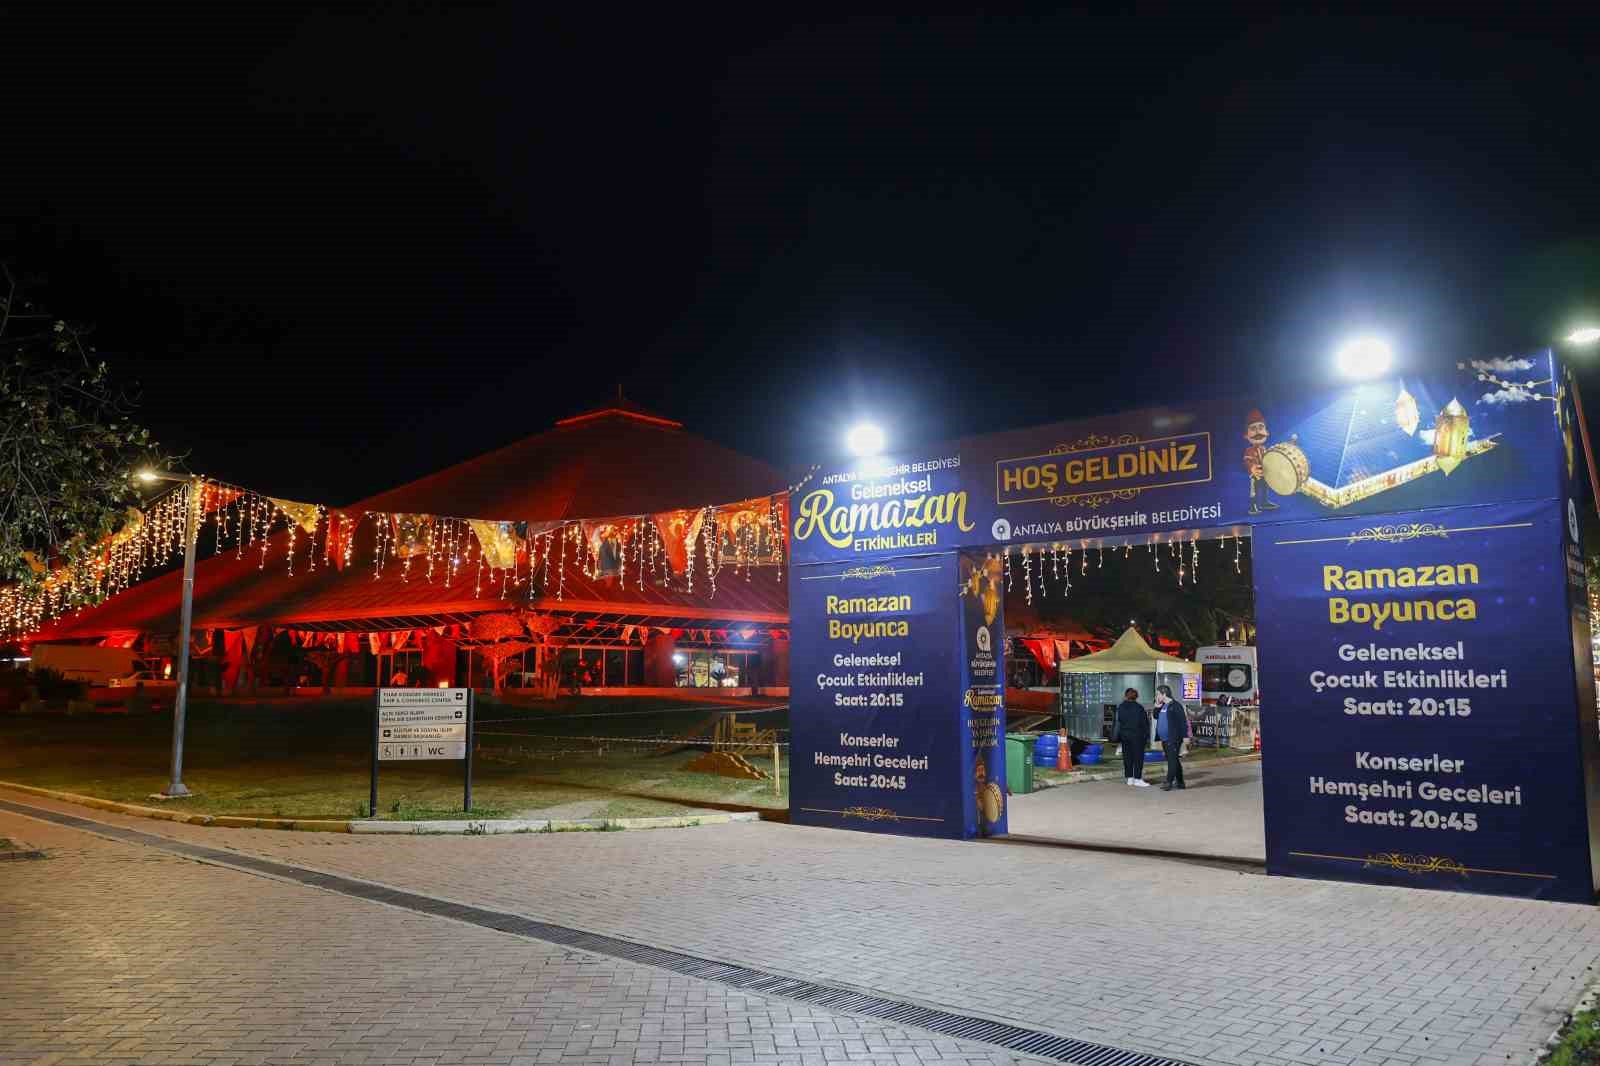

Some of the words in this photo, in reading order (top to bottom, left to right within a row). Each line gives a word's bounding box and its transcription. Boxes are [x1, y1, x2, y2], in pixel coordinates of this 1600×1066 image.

[823, 472, 857, 487] ANTALYA
[912, 453, 961, 474] BELEDİYESİ
[1003, 463, 1058, 493] HOŞ
[1065, 441, 1199, 486] GELDİNİZ
[851, 474, 932, 500] Geleneksel
[794, 489, 976, 549] Ramazan
[1012, 521, 1063, 537] ANTALYA
[1066, 511, 1147, 533] BÜYÜKŞEHİR
[1152, 502, 1221, 524] BELEDİYESİ
[854, 528, 937, 552] ETKİNLİKLERİ
[1322, 562, 1479, 592] Ramazan
[826, 594, 912, 615] Ramazan
[1328, 596, 1477, 630] Boyunca
[829, 619, 909, 644] Boyunca
[833, 651, 901, 667] Geleneksel
[1338, 641, 1464, 662] Geleneksel
[816, 672, 855, 690] Çocuk
[857, 672, 924, 687] Etkinlikleri
[1310, 670, 1378, 692] Çocuk
[1383, 669, 1508, 689] Etkinlikleri
[834, 693, 868, 707] Saat:
[869, 693, 904, 707] 20:15
[1343, 697, 1404, 716] Saat:
[1408, 697, 1473, 717] 20:15
[428, 747, 446, 756] WC
[840, 733, 900, 748] Konserler
[814, 751, 871, 770] Hemşehri
[873, 754, 929, 770] Geceleri
[1355, 752, 1465, 774] Konserler
[834, 772, 868, 787] Saat:
[869, 774, 907, 790] 20:45
[1310, 776, 1413, 802] Hemşehri
[1418, 781, 1522, 806] Geceleri
[1344, 804, 1405, 827] Saat:
[1410, 809, 1479, 832] 20:45
